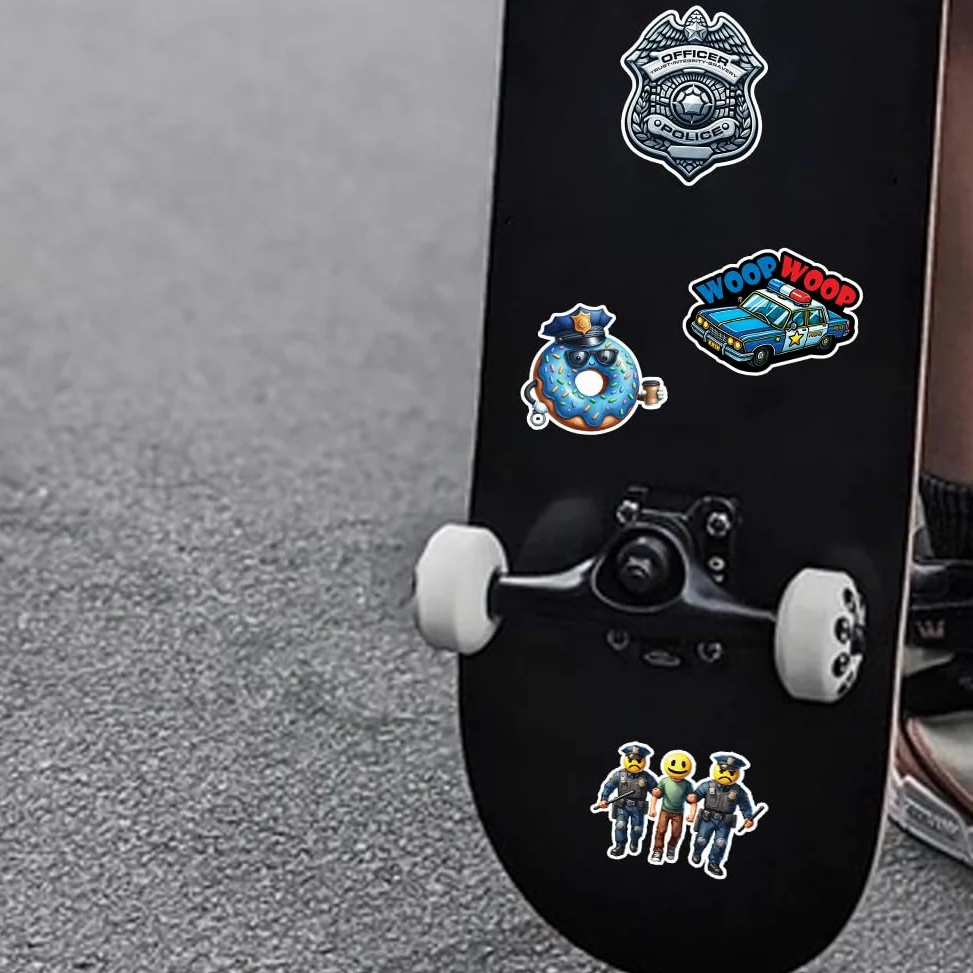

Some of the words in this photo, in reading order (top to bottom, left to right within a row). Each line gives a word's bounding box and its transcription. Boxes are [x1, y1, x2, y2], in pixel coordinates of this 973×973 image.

[661, 49, 729, 67] OFFICER
[661, 123, 724, 141] POLICE
[696, 255, 777, 305] WOOP
[781, 254, 857, 307] WOOP
